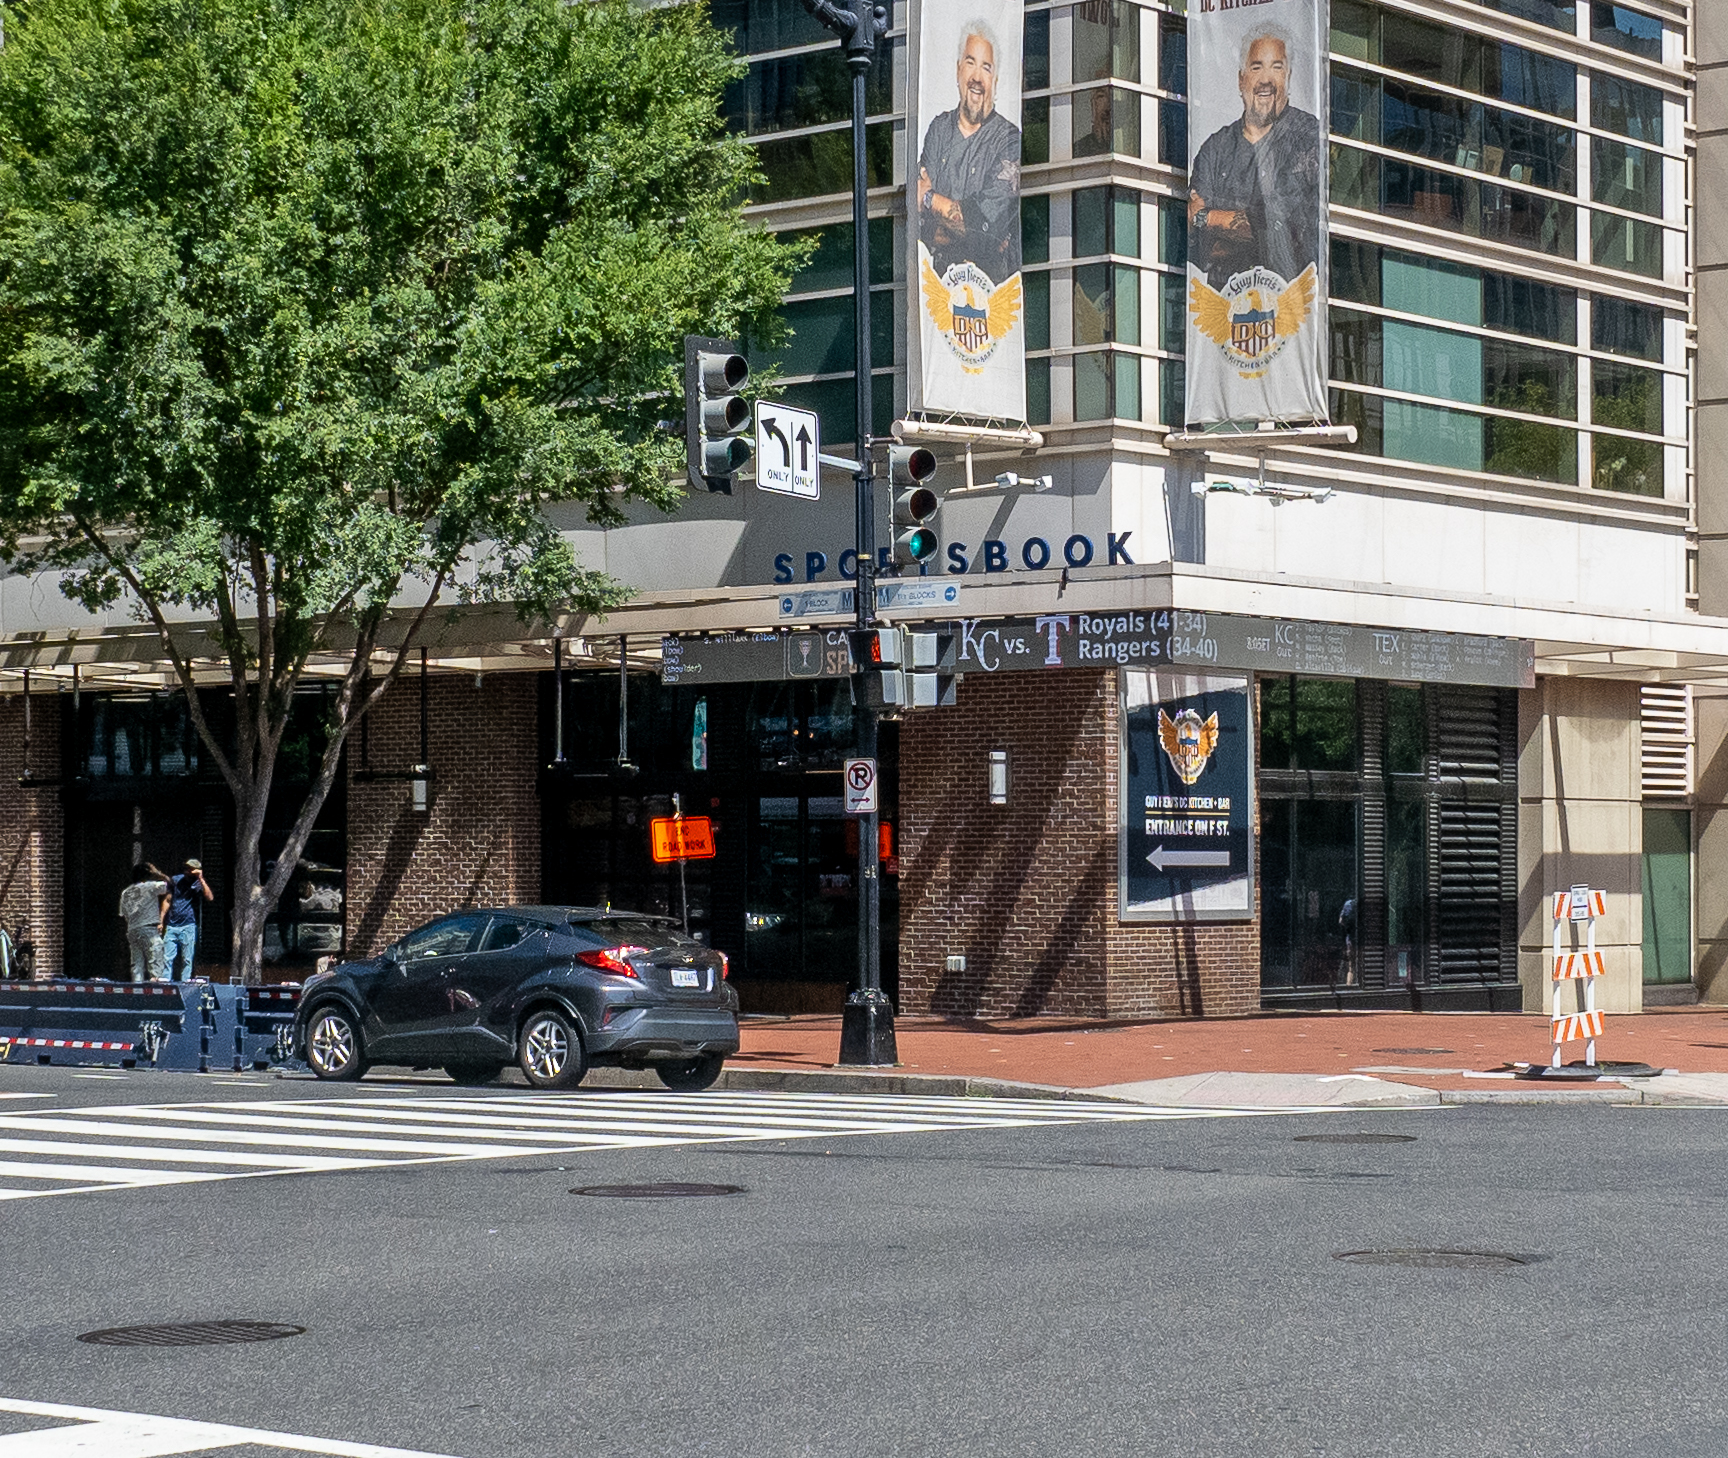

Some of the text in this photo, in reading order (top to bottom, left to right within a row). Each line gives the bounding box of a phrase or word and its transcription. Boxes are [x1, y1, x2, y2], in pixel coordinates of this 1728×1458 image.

[768, 469, 789, 482] ONLY
[795, 476, 814, 487] ONLY
[773, 531, 1135, 584] SPOSBOOK
[1078, 611, 1208, 640] Royals (41-34)
[1275, 624, 1293, 645] KC
[1372, 633, 1399, 653] TEX
[1003, 637, 1030, 654] vs.
[1078, 635, 1218, 663] Rangers (34-40)
[1188, 797, 1213, 809] KITCHEN
[1145, 819, 1230, 836] ENTRANCE ON F ST.
[685, 840, 706, 851] WORK
